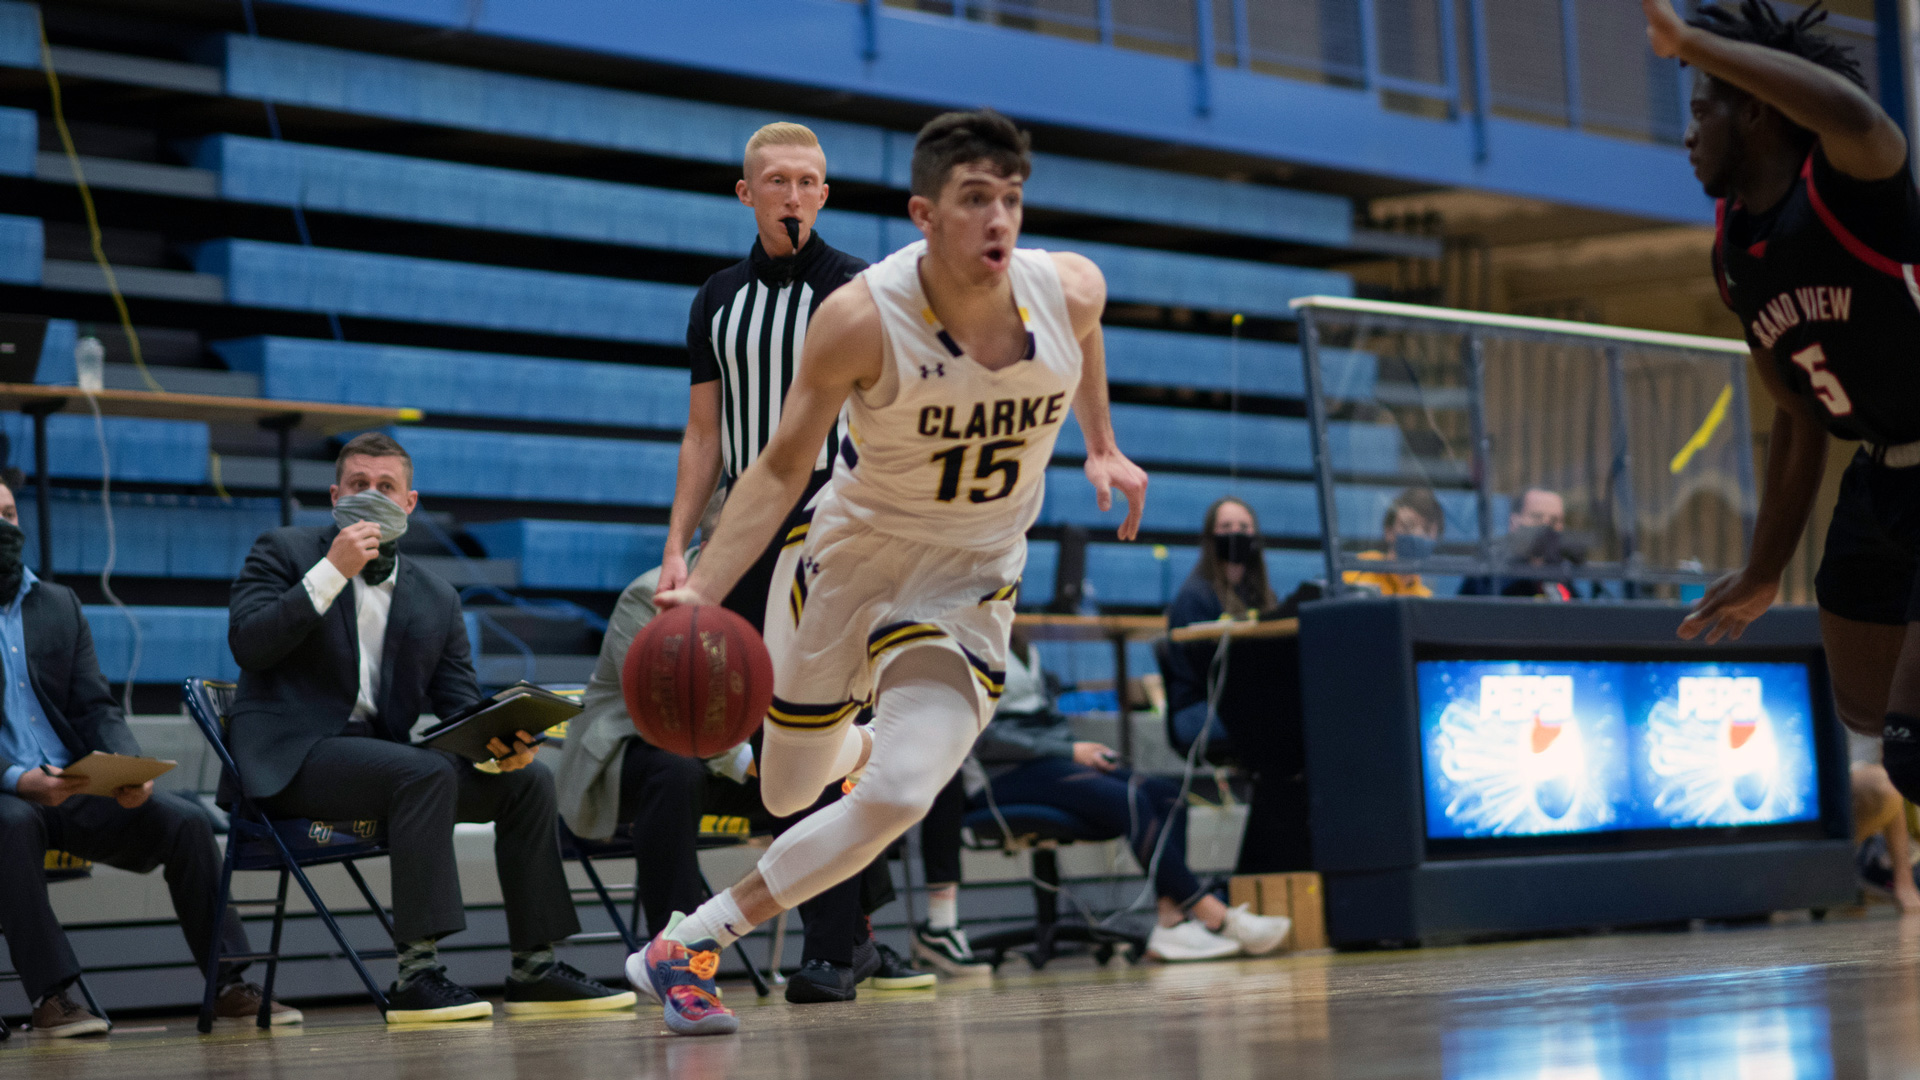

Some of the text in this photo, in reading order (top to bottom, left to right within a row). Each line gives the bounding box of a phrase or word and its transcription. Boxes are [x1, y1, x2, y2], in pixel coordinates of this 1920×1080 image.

[1751, 286, 1852, 349] RAND VIEW
[1790, 341, 1852, 416] 5
[917, 390, 1066, 439] CLARKE
[930, 438, 1027, 503] 15
